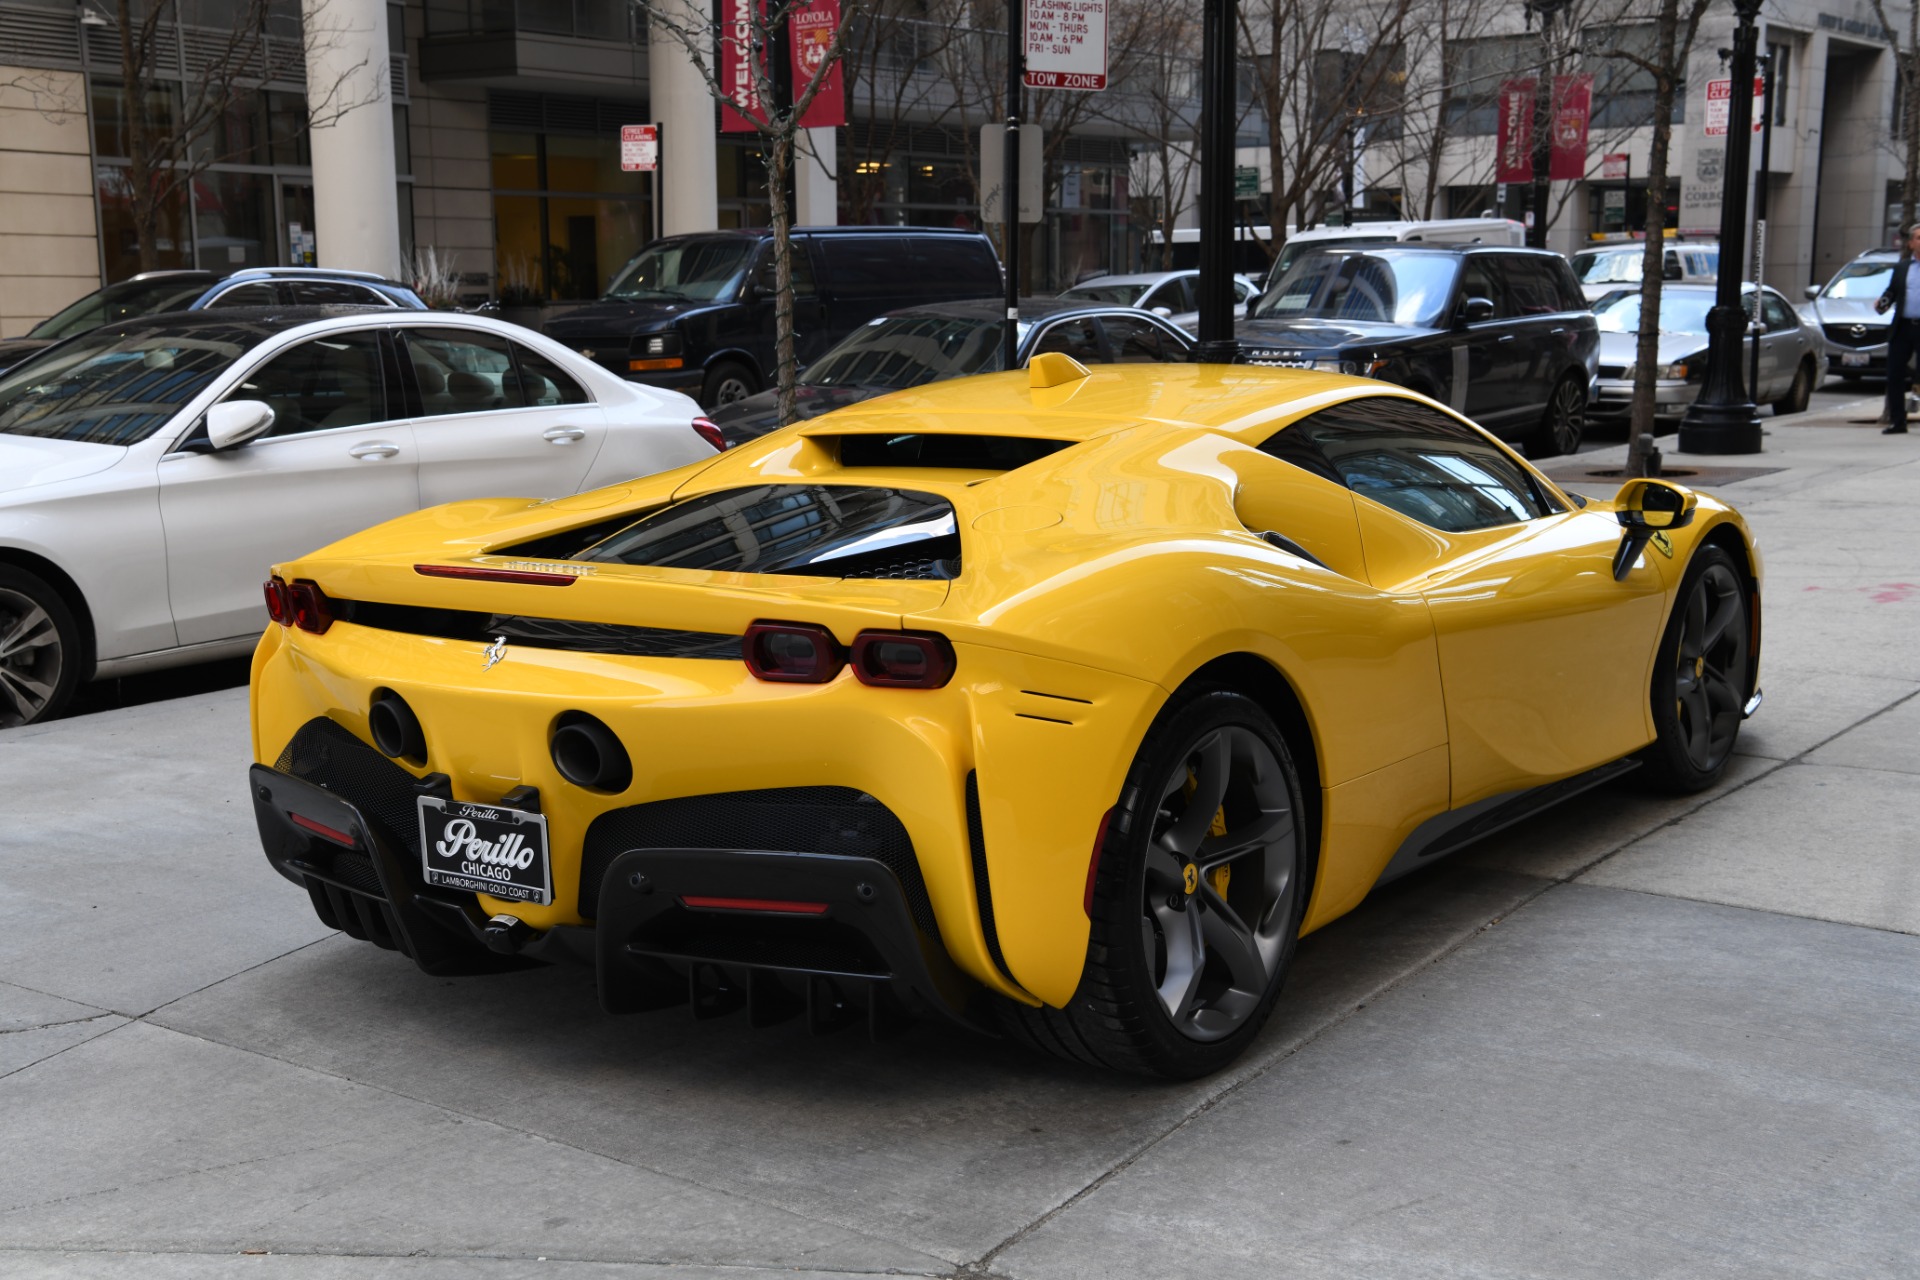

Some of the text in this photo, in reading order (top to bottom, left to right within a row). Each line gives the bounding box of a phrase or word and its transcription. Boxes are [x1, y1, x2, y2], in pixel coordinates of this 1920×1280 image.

[1029, 0, 1103, 13] FLASHING LIGHTS
[796, 10, 833, 25] LOYOLA
[1030, 10, 1039, 19] 10
[1041, 11, 1054, 20] AM
[1063, 12, 1069, 21] 8
[1072, 13, 1085, 21] PM
[1029, 21, 1049, 31] MON
[1059, 23, 1088, 34] THURS
[1030, 32, 1038, 41] 10
[1040, 33, 1053, 42] AM
[1062, 35, 1068, 43] 6
[1070, 35, 1083, 44] PM
[1029, 43, 1044, 52] FRI
[1052, 45, 1071, 54] SUN
[1029, 72, 1099, 88] TOW ZONE
[1685, 191, 1723, 201] CORBO
[459, 805, 500, 820] Perillo
[436, 819, 534, 870] Perillo
[461, 861, 511, 881] CHICAGO
[442, 875, 530, 899] LAMBORGHINI GOLD COAST
